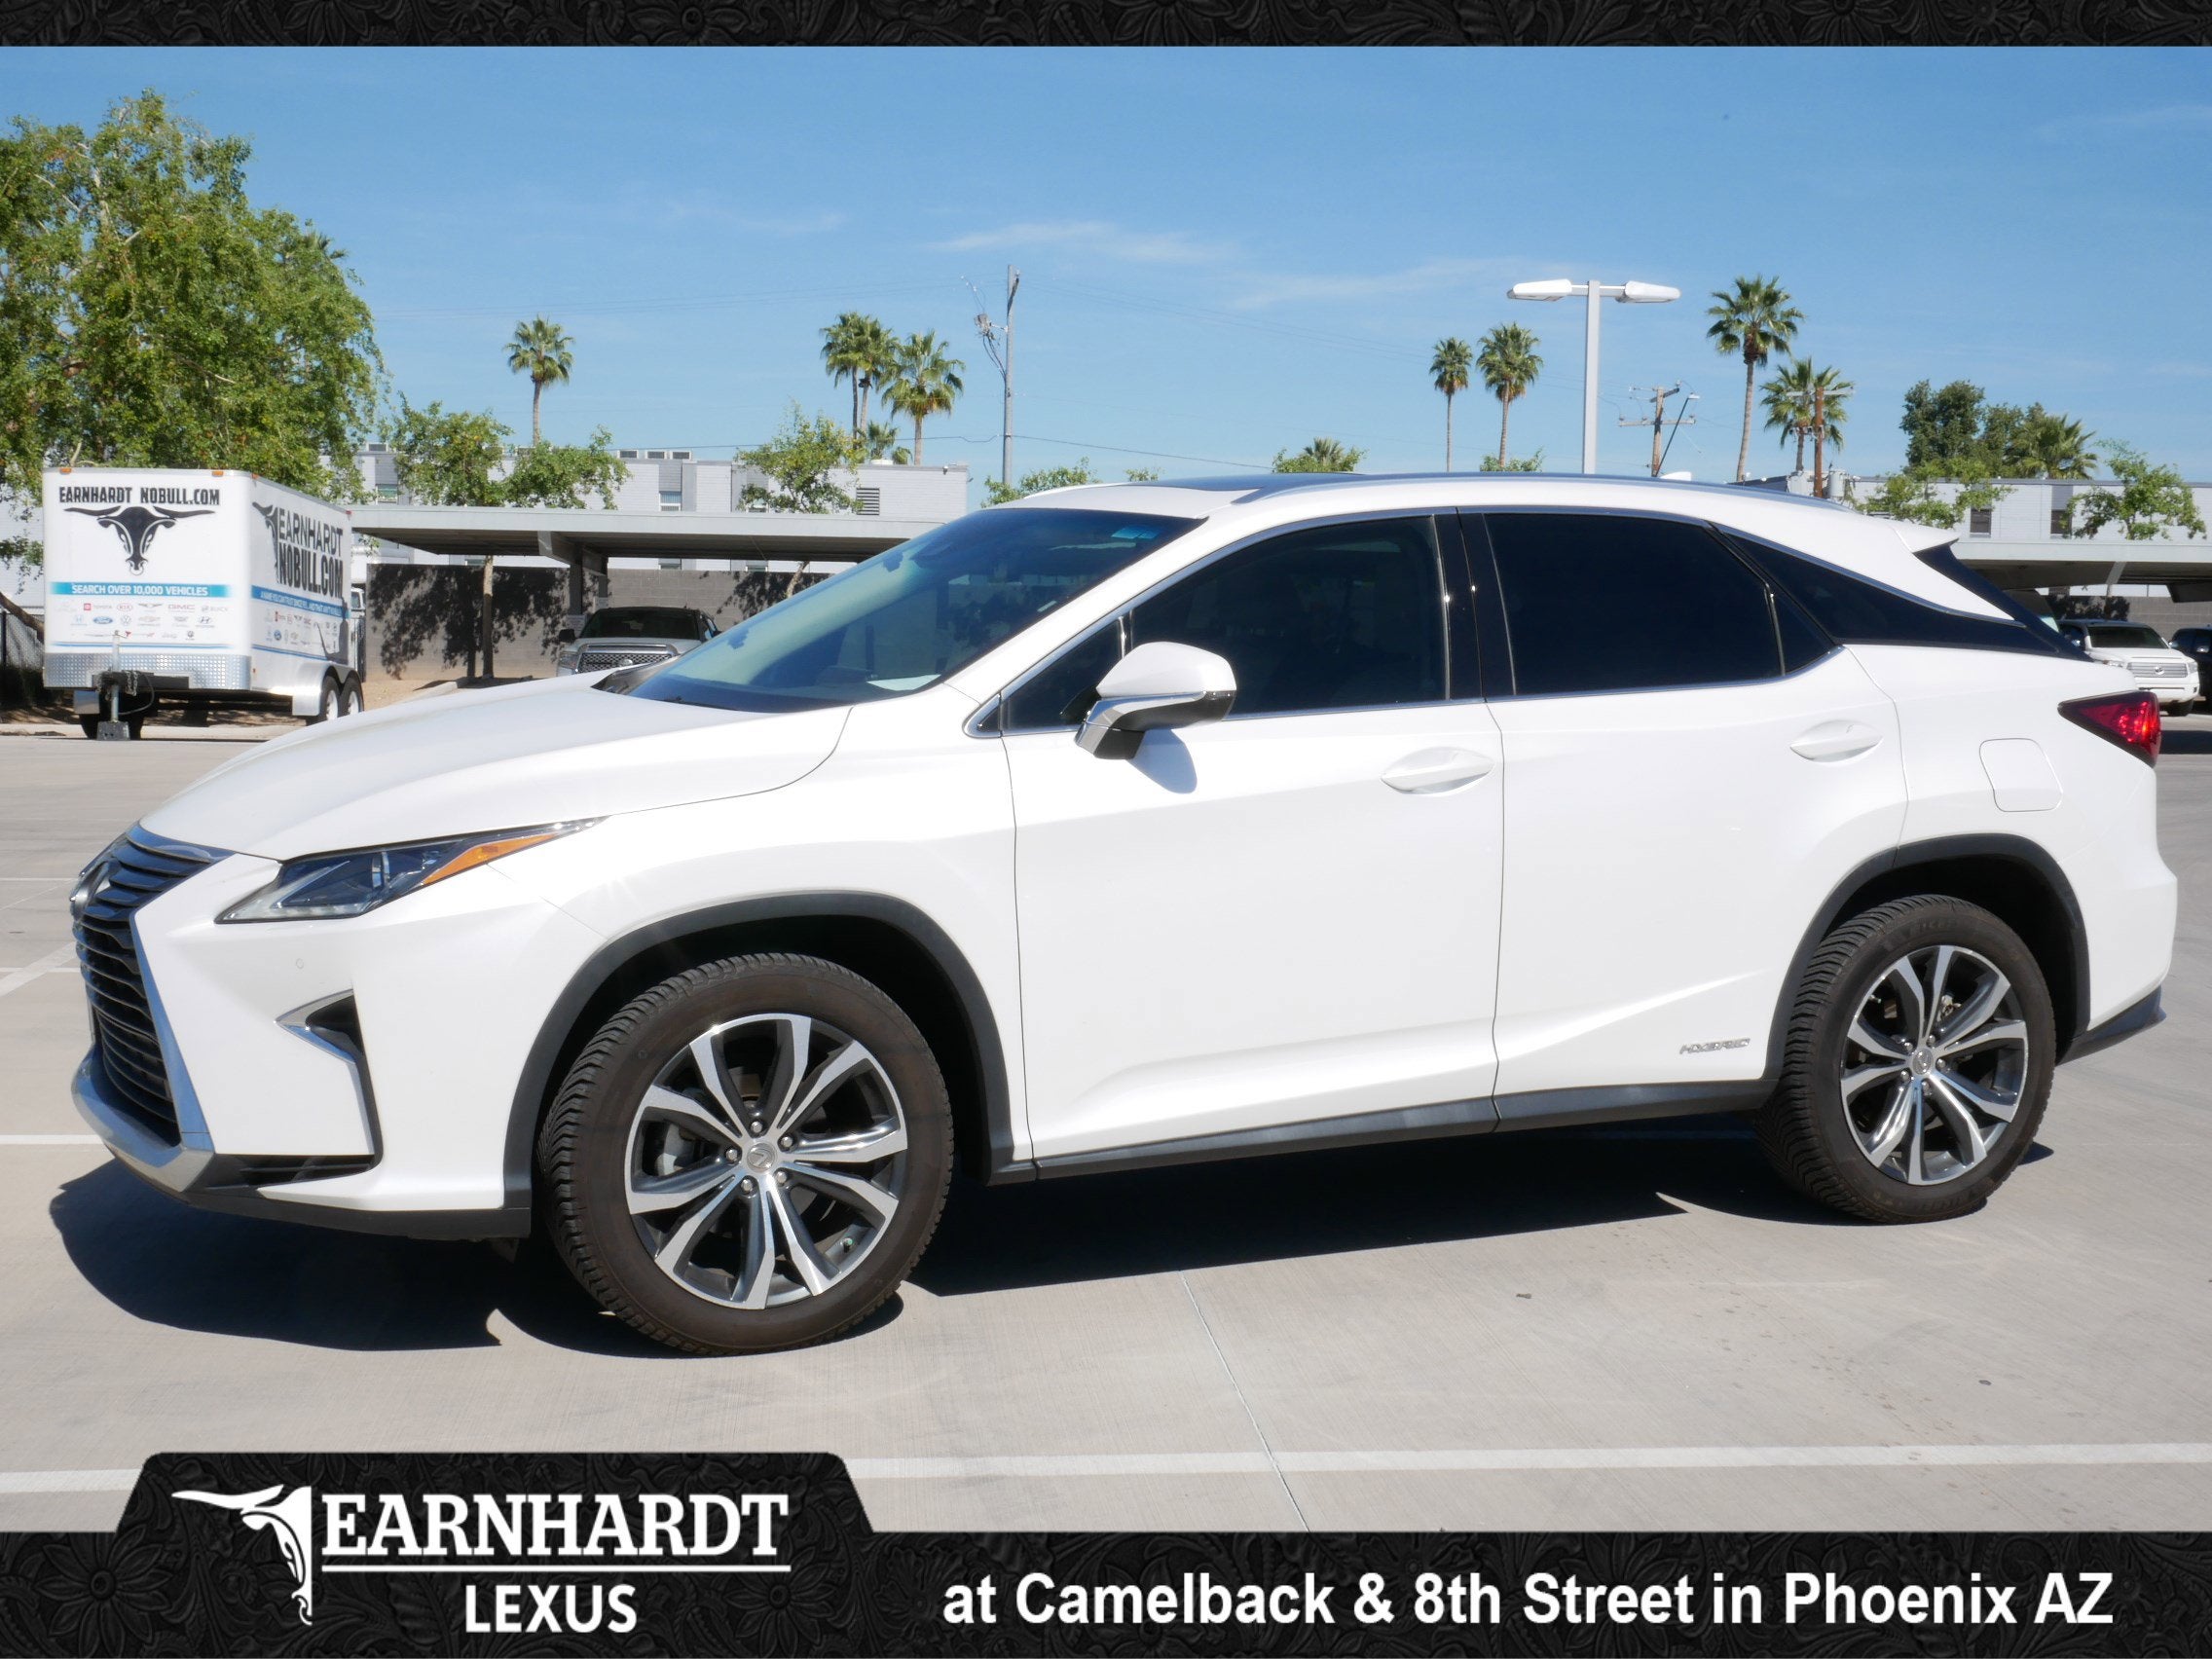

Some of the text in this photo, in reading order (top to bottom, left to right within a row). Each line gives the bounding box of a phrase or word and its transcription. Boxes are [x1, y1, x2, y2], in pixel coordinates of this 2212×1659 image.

[59, 486, 221, 505] EARNHARDT NOBULL.COM
[278, 507, 344, 557] EARNHARDT
[278, 541, 344, 600] NOBULL.COM
[72, 584, 208, 596] SEARCH OVER 10,000 VEHICLES
[1678, 1038, 1751, 1055] HYBRID
